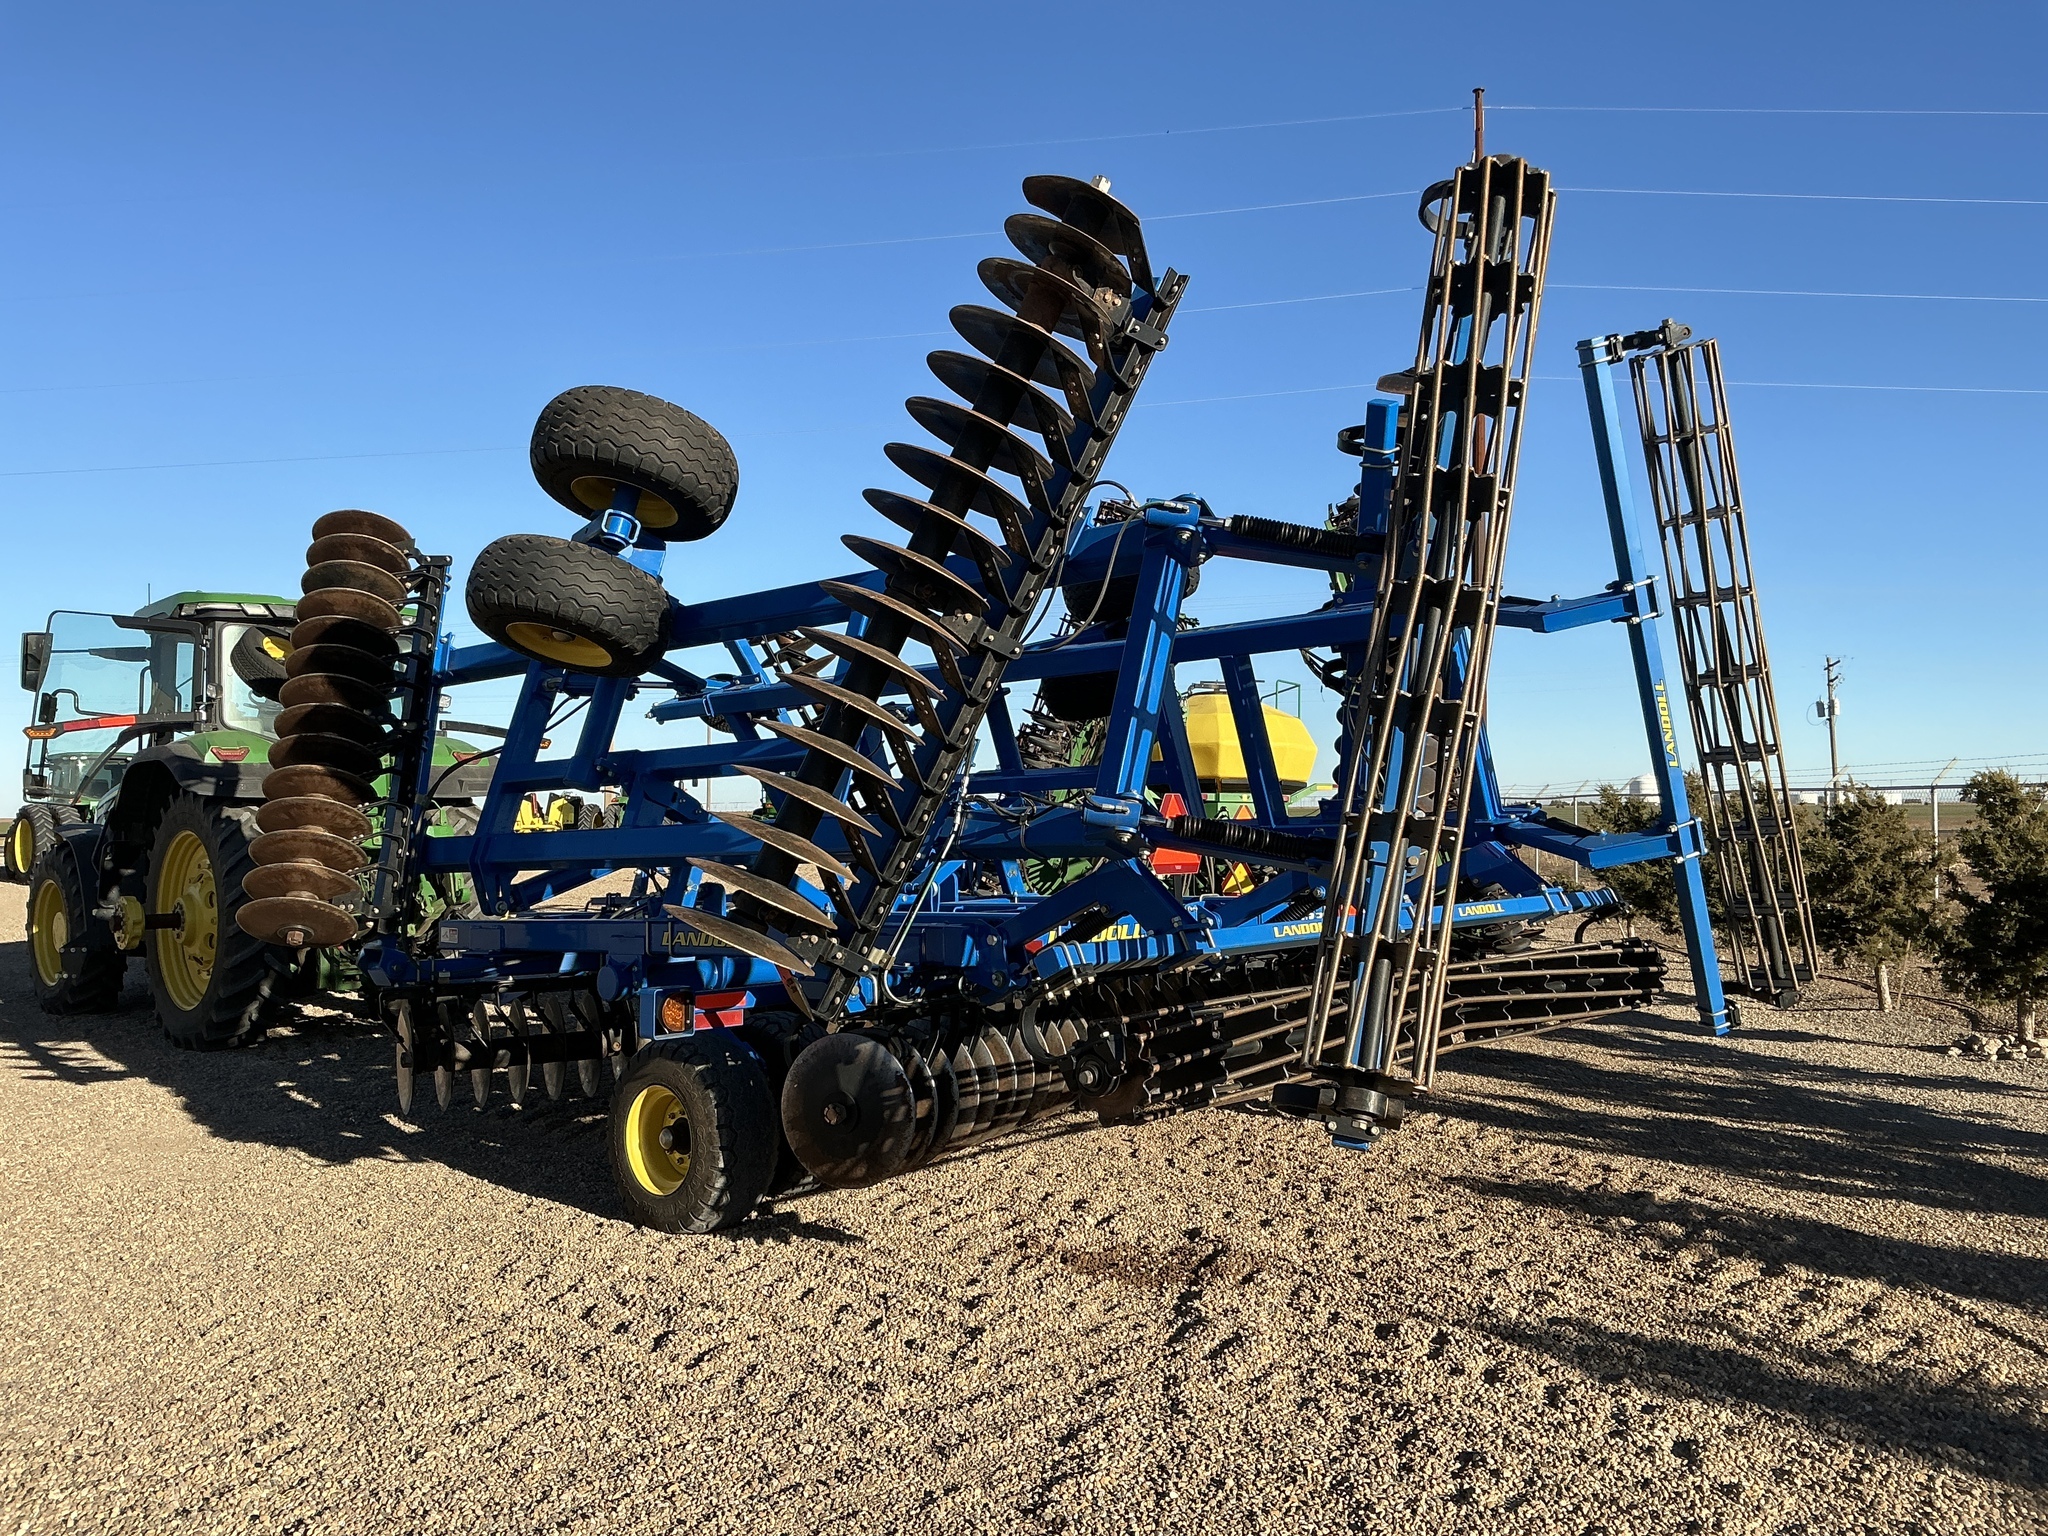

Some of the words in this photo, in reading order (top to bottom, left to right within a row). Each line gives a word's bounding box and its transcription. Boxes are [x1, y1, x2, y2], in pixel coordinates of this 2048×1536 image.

[1654, 679, 1679, 767] LANDOLL
[1458, 903, 1505, 917] LANDOLL
[661, 931, 732, 948] LANDO
[1047, 923, 1143, 944] LDOLL
